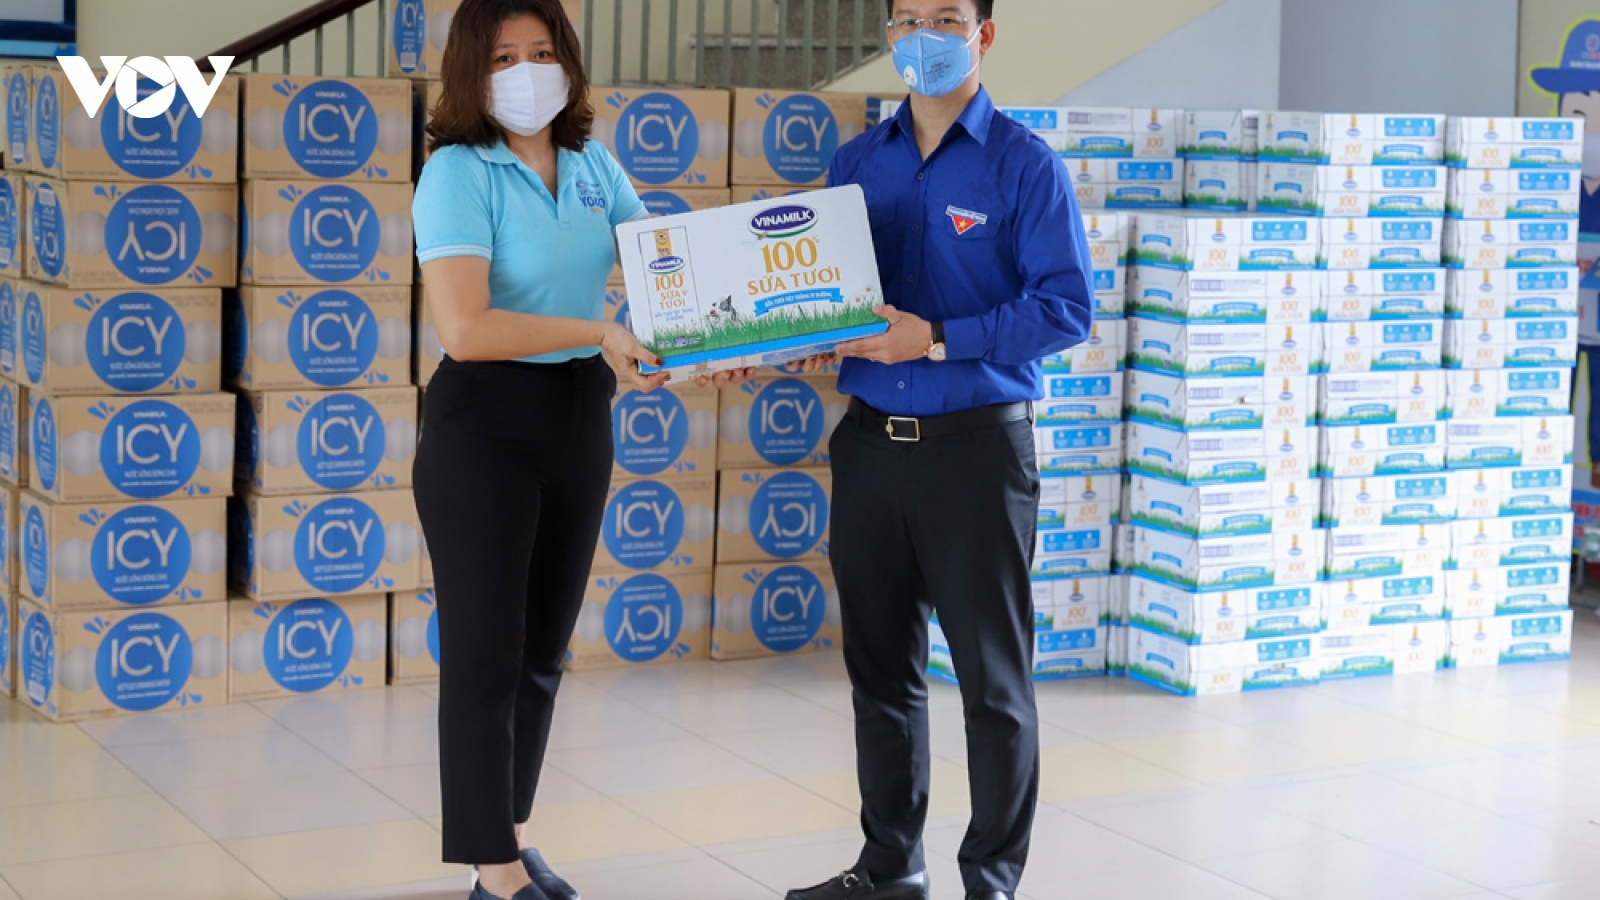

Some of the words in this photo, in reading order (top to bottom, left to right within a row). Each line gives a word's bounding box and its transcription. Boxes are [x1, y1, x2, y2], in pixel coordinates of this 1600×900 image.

[118, 103, 189, 142] ICY
[299, 103, 366, 143] ICY
[628, 114, 689, 151] ICY
[775, 114, 830, 151] ICY
[304, 207, 369, 247] ICY
[754, 209, 812, 228] VINAMILK
[117, 221, 186, 261] ICY
[747, 275, 787, 296] SỮA
[789, 266, 841, 288] TƯƠI
[102, 316, 172, 357] ICY
[302, 312, 367, 352] ICY
[311, 415, 374, 457] ICY
[620, 406, 678, 444] ICY
[761, 399, 815, 434] ICY
[116, 423, 188, 465] ICY
[615, 500, 675, 538] ICY
[759, 502, 816, 538] ICY
[107, 527, 178, 571] ICY
[308, 519, 374, 560] ICY
[614, 604, 671, 644] ICY
[763, 585, 816, 623] ICY
[111, 633, 180, 678] ICY
[278, 617, 342, 661] ICY
